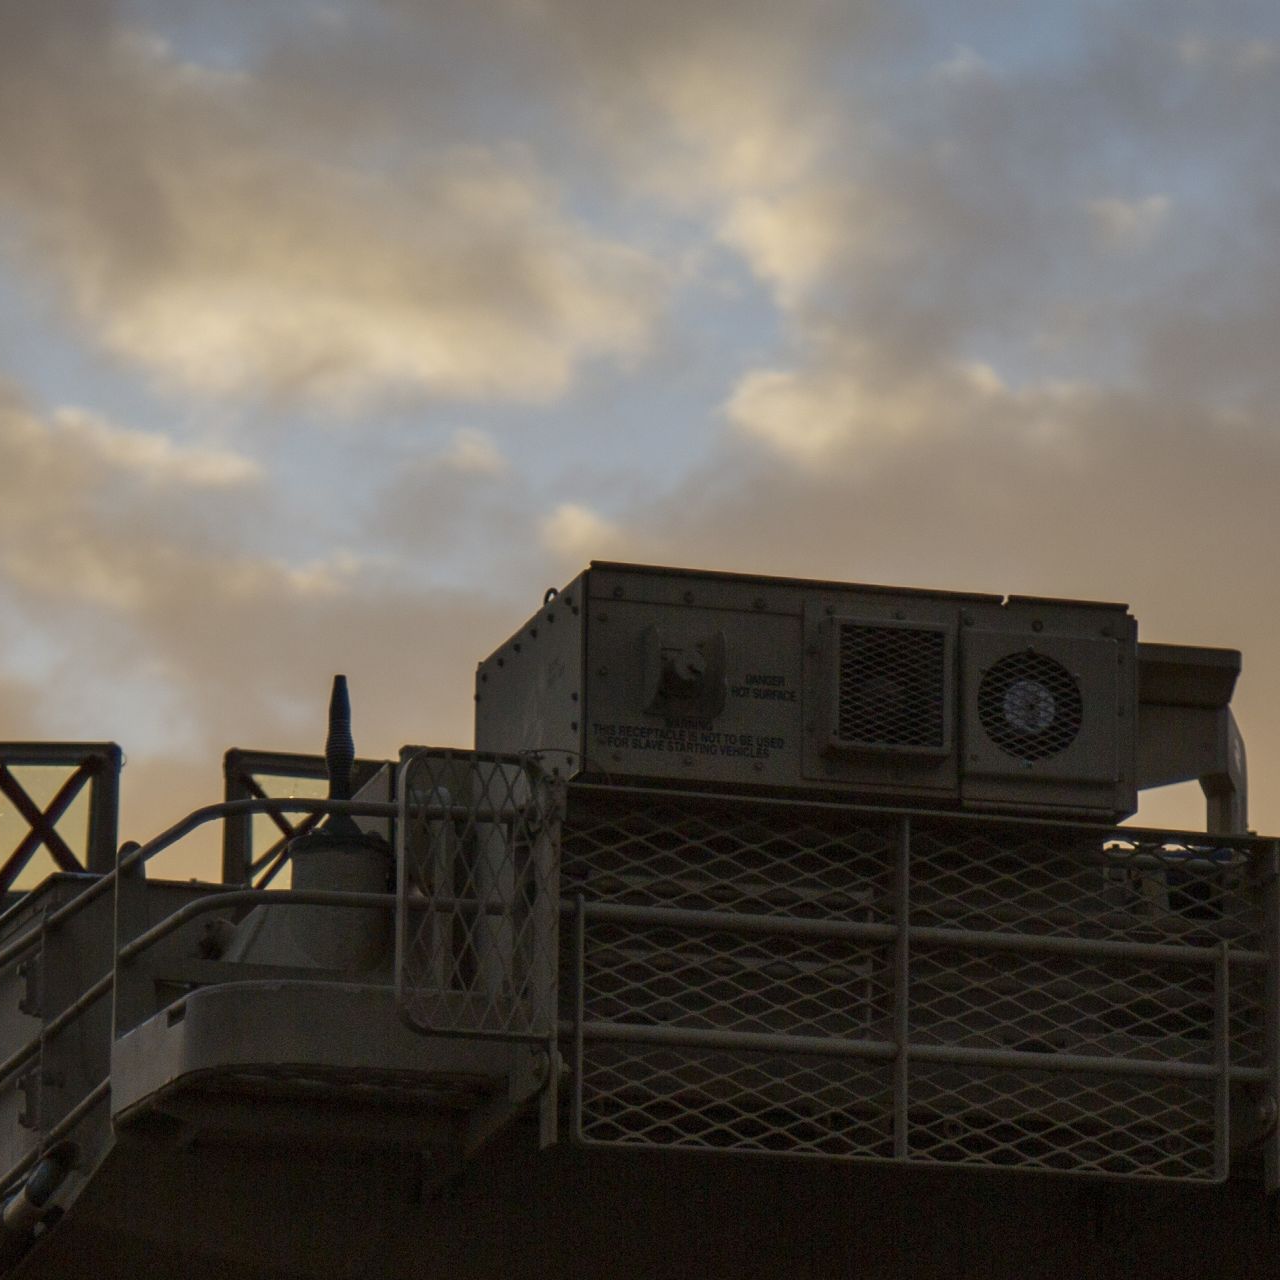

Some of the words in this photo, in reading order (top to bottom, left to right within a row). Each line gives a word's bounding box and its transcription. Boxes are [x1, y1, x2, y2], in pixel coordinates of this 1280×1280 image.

[745, 674, 785, 687] DANGER
[731, 686, 750, 698] HOT
[753, 689, 797, 702] SURFACE
[665, 717, 713, 731] WARNING
[593, 723, 616, 736] THIS
[619, 725, 685, 742] RECEPTACLE
[689, 730, 697, 742] IS
[701, 731, 720, 743] NOT
[723, 732, 736, 745] TO
[739, 734, 753, 747] BE
[757, 735, 785, 749] USED
[607, 736, 629, 748] FOR
[632, 738, 664, 751] SLAVE
[667, 740, 717, 755] STARTING
[720, 744, 770, 758] VEHICLES
